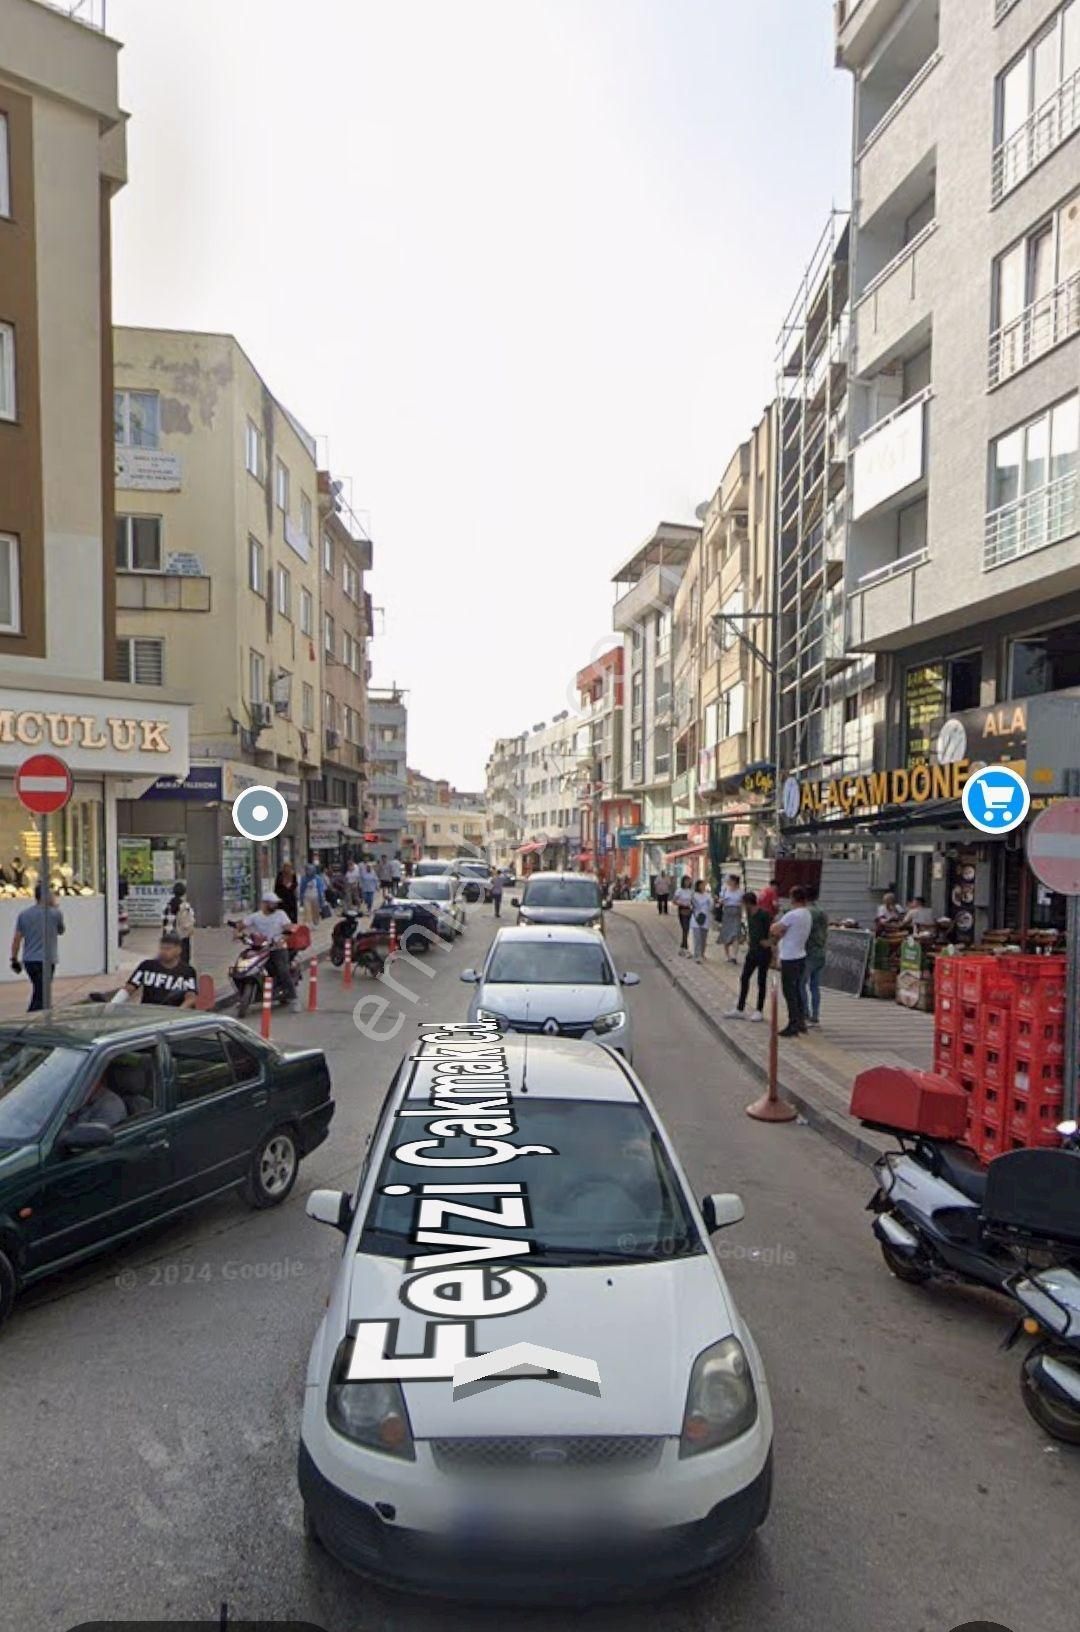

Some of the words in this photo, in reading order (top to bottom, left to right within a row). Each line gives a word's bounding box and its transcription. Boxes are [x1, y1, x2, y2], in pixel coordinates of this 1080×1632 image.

[800, 771, 888, 815] ALAÇAM
[893, 757, 971, 804] DÖNE
[131, 970, 196, 992] LUFIAN
